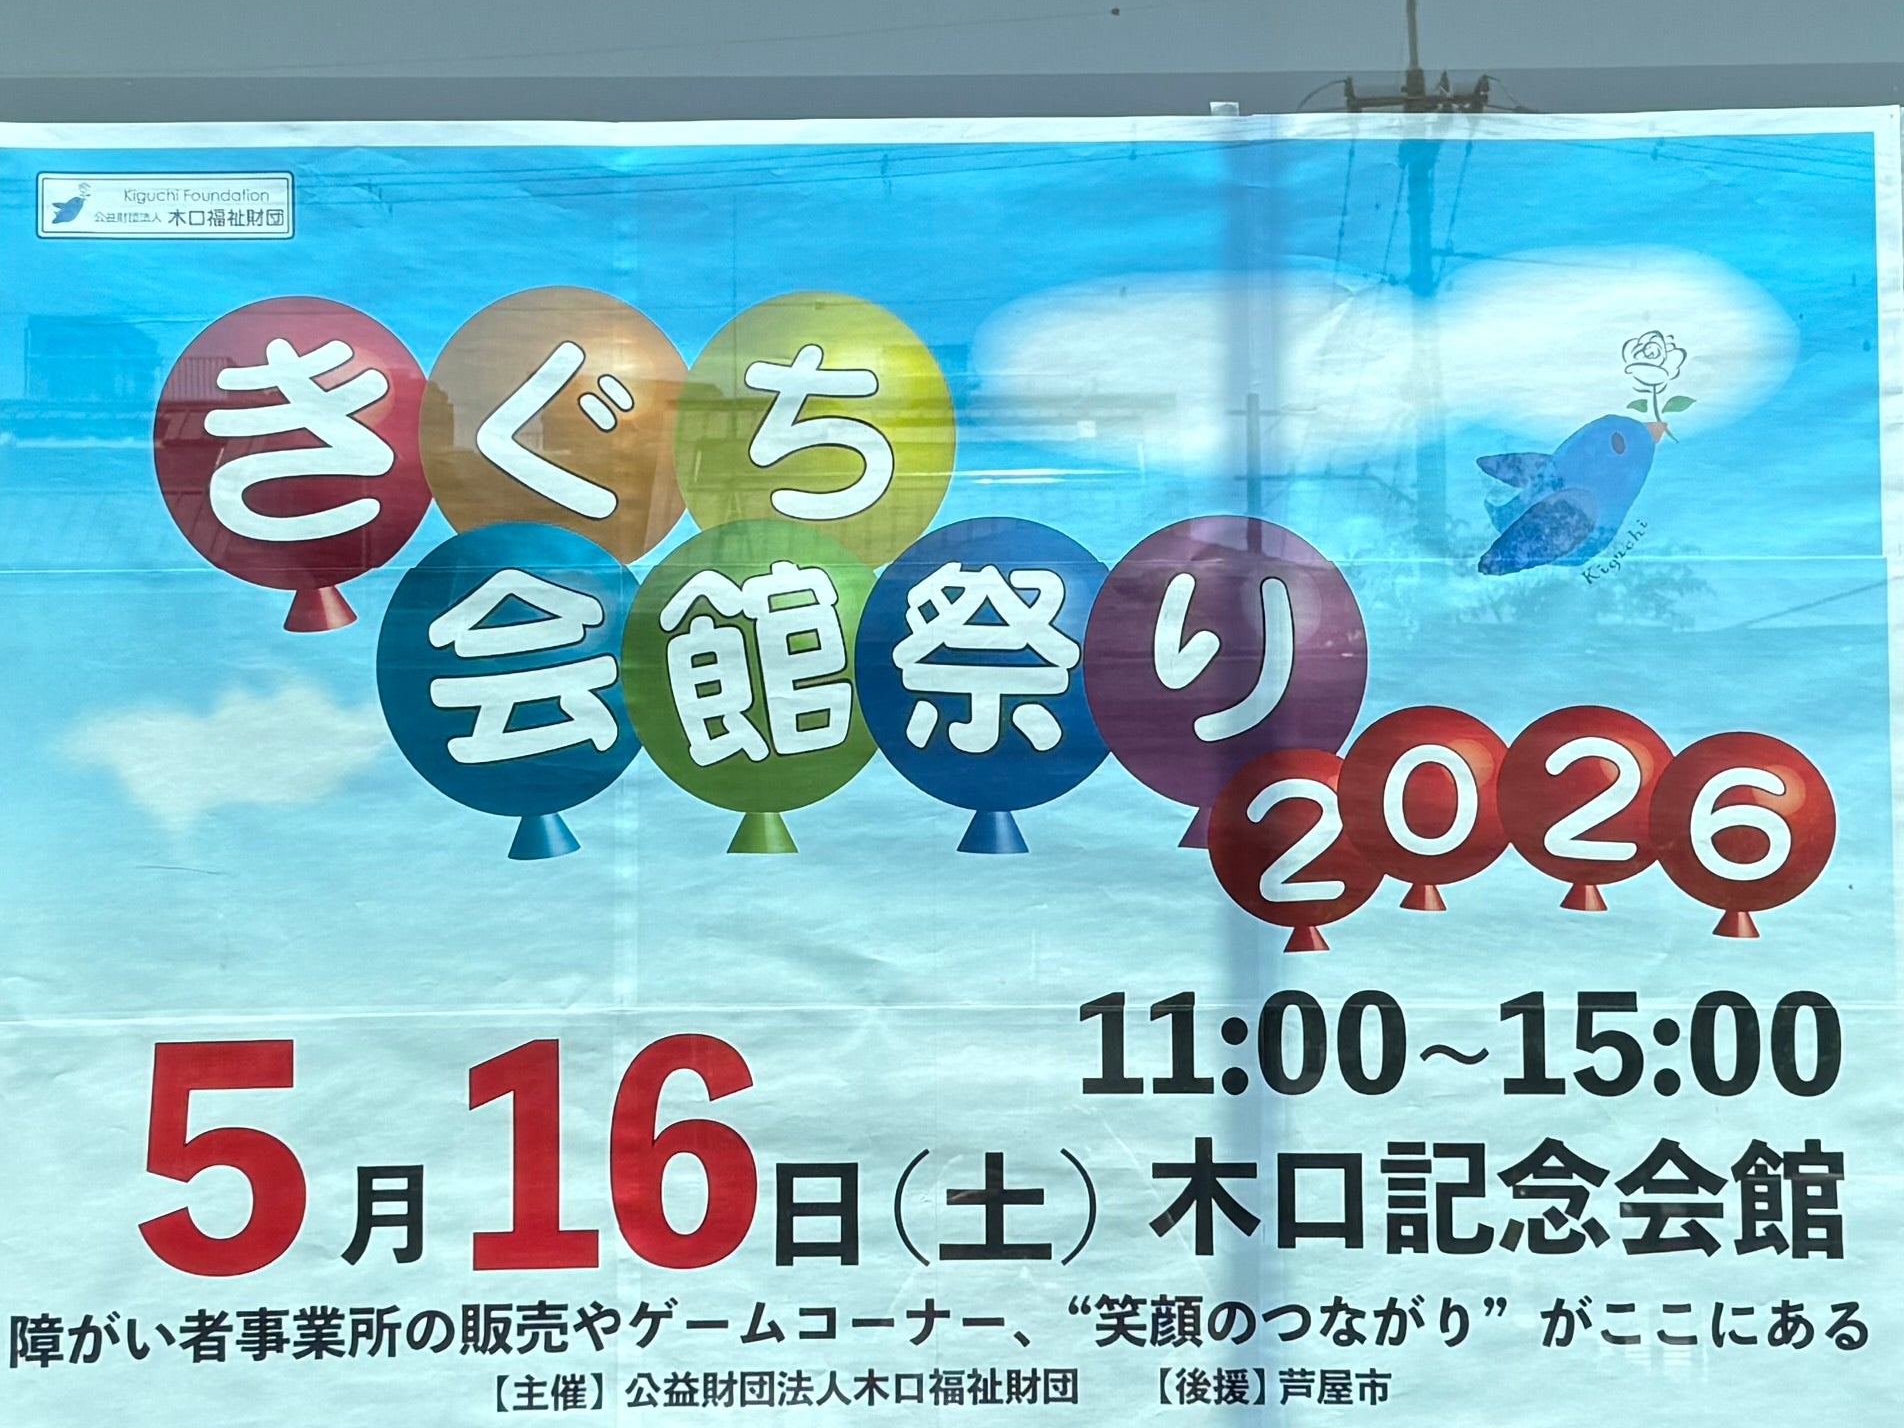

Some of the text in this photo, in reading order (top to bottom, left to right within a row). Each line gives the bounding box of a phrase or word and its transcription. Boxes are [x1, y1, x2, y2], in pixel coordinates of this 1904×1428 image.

[124, 188, 270, 205] Kiguchi Foundation
[168, 208, 284, 227] 木口福祉財団
[203, 337, 896, 542] きぐち
[1581, 519, 1648, 585] Kiguchi
[427, 559, 1295, 766] 会館祭り
[1246, 735, 1793, 904] 2026
[1150, 1136, 1846, 1259] 木口記念会館
